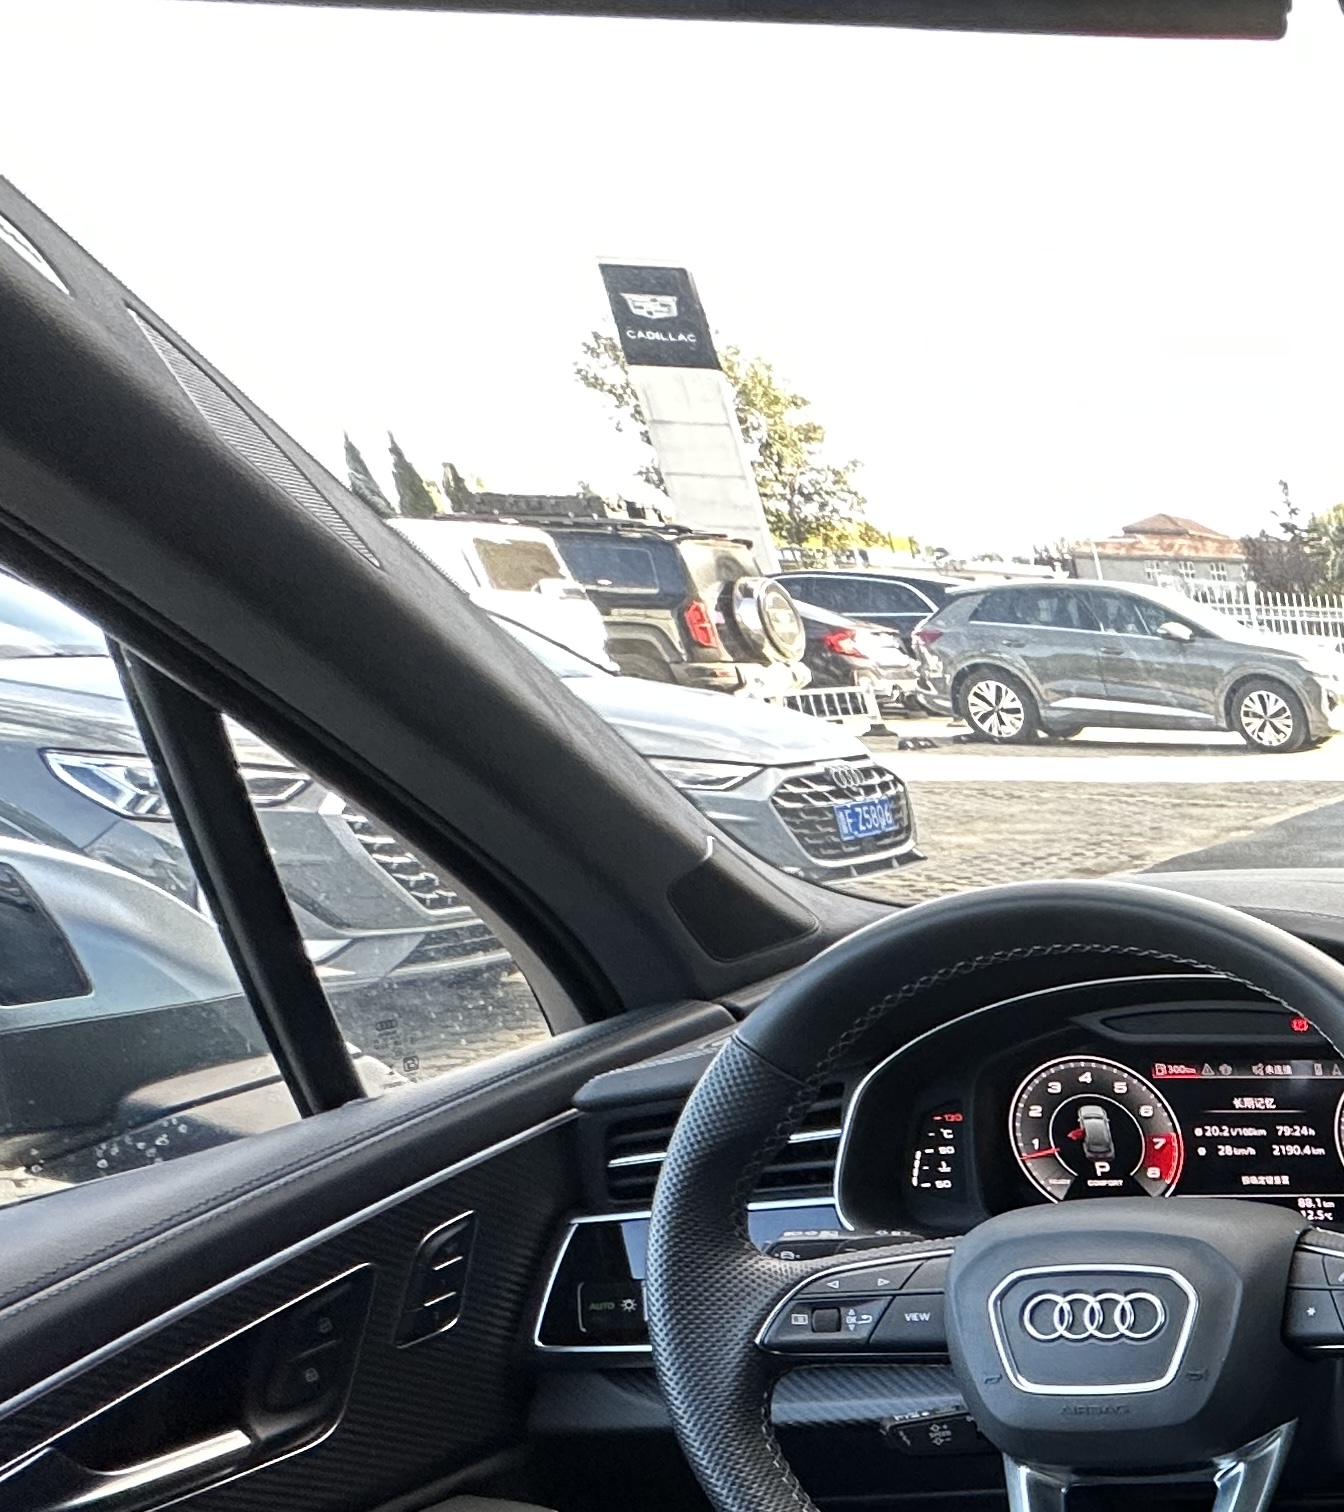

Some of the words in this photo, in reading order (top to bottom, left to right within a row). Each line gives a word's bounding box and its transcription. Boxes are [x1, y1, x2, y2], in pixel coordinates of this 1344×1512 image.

[626, 330, 697, 342] CADILLAC
[1078, 1071, 1092, 1084] 4
[1047, 1081, 1062, 1094] 3
[1113, 1081, 1128, 1094] 5
[1232, 1097, 1277, 1110] 长期记忆
[1028, 1105, 1043, 1118] 2
[1139, 1105, 1154, 1118] 6
[1031, 1138, 1040, 1151] 1
[1152, 1137, 1167, 1150] 7
[1094, 1161, 1111, 1177] P
[1146, 1167, 1161, 1179] 8
[589, 1302, 616, 1311] AUTO
[904, 1312, 931, 1322] VIEW
[1060, 1405, 1130, 1416] AIRBAG
